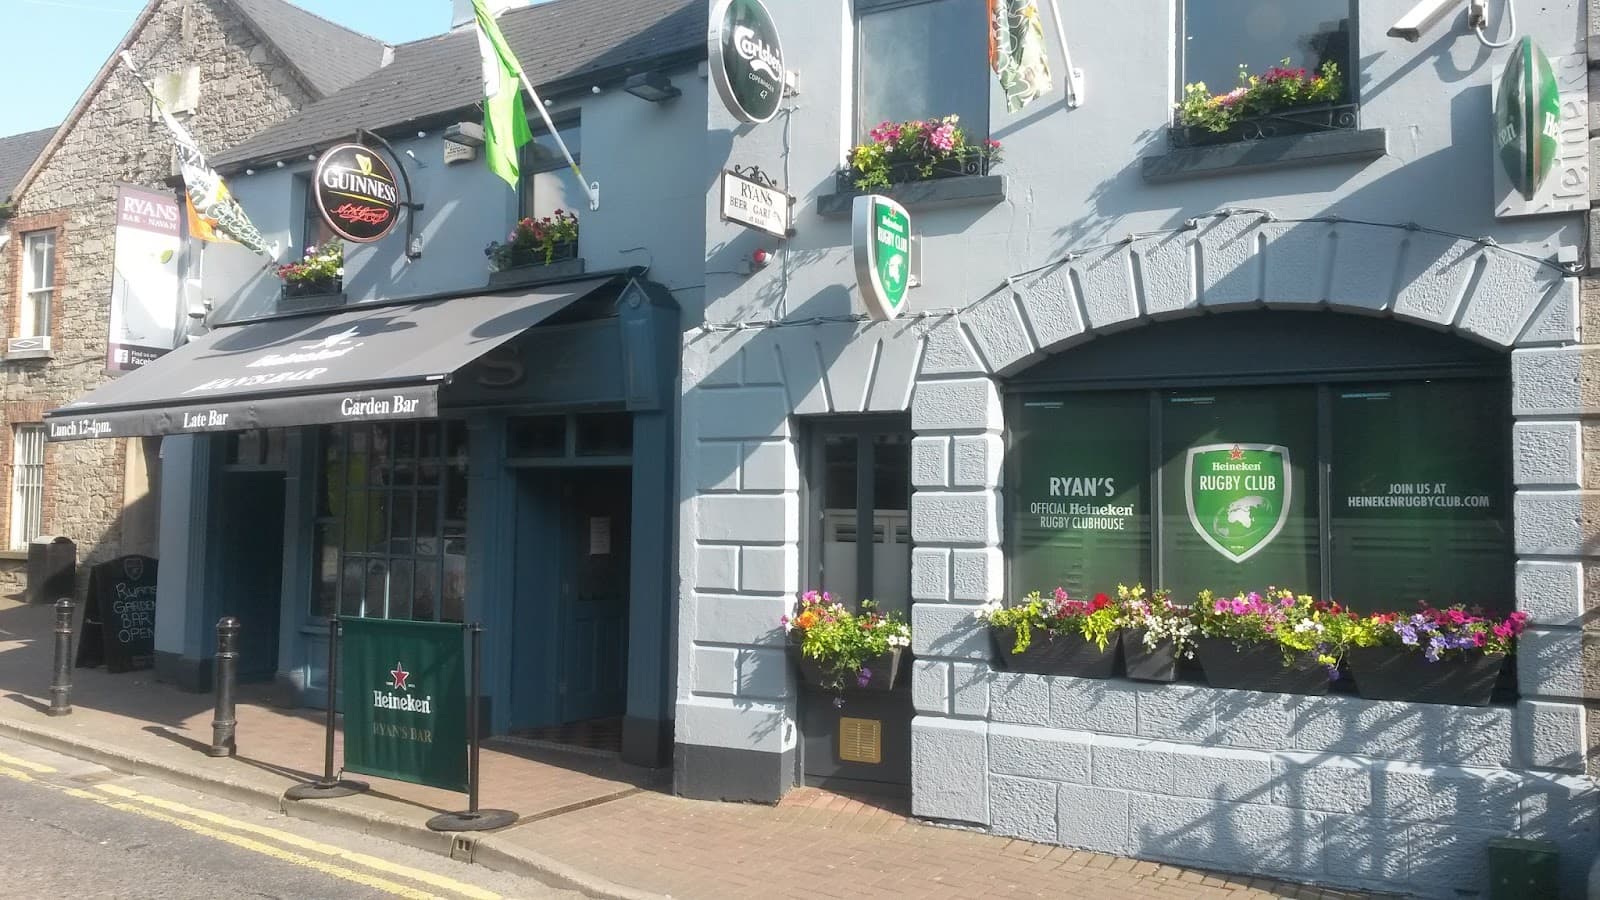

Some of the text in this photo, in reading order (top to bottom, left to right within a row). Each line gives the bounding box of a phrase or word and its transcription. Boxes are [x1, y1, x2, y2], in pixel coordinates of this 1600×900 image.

[323, 167, 396, 203] GUINNESS
[741, 182, 773, 206] RYANS
[124, 196, 177, 221] RYANS
[729, 196, 748, 211] BEER
[341, 395, 419, 415] Garden Bar
[183, 410, 229, 428] Late Bar
[50, 421, 77, 437] Lunch
[1212, 462, 1261, 471] Heineken
[1049, 477, 1115, 497] RYAN'S
[1199, 475, 1276, 491] RUGBY CLUB
[1388, 483, 1447, 495] JOIN US AT
[1030, 502, 1134, 516] OFFICIAL Heineken
[1347, 496, 1490, 508] HEINEKENRUGBYCLUB.COM
[1040, 516, 1125, 530] RUGBY CLUBHOUSE
[373, 690, 431, 714] Heineken
